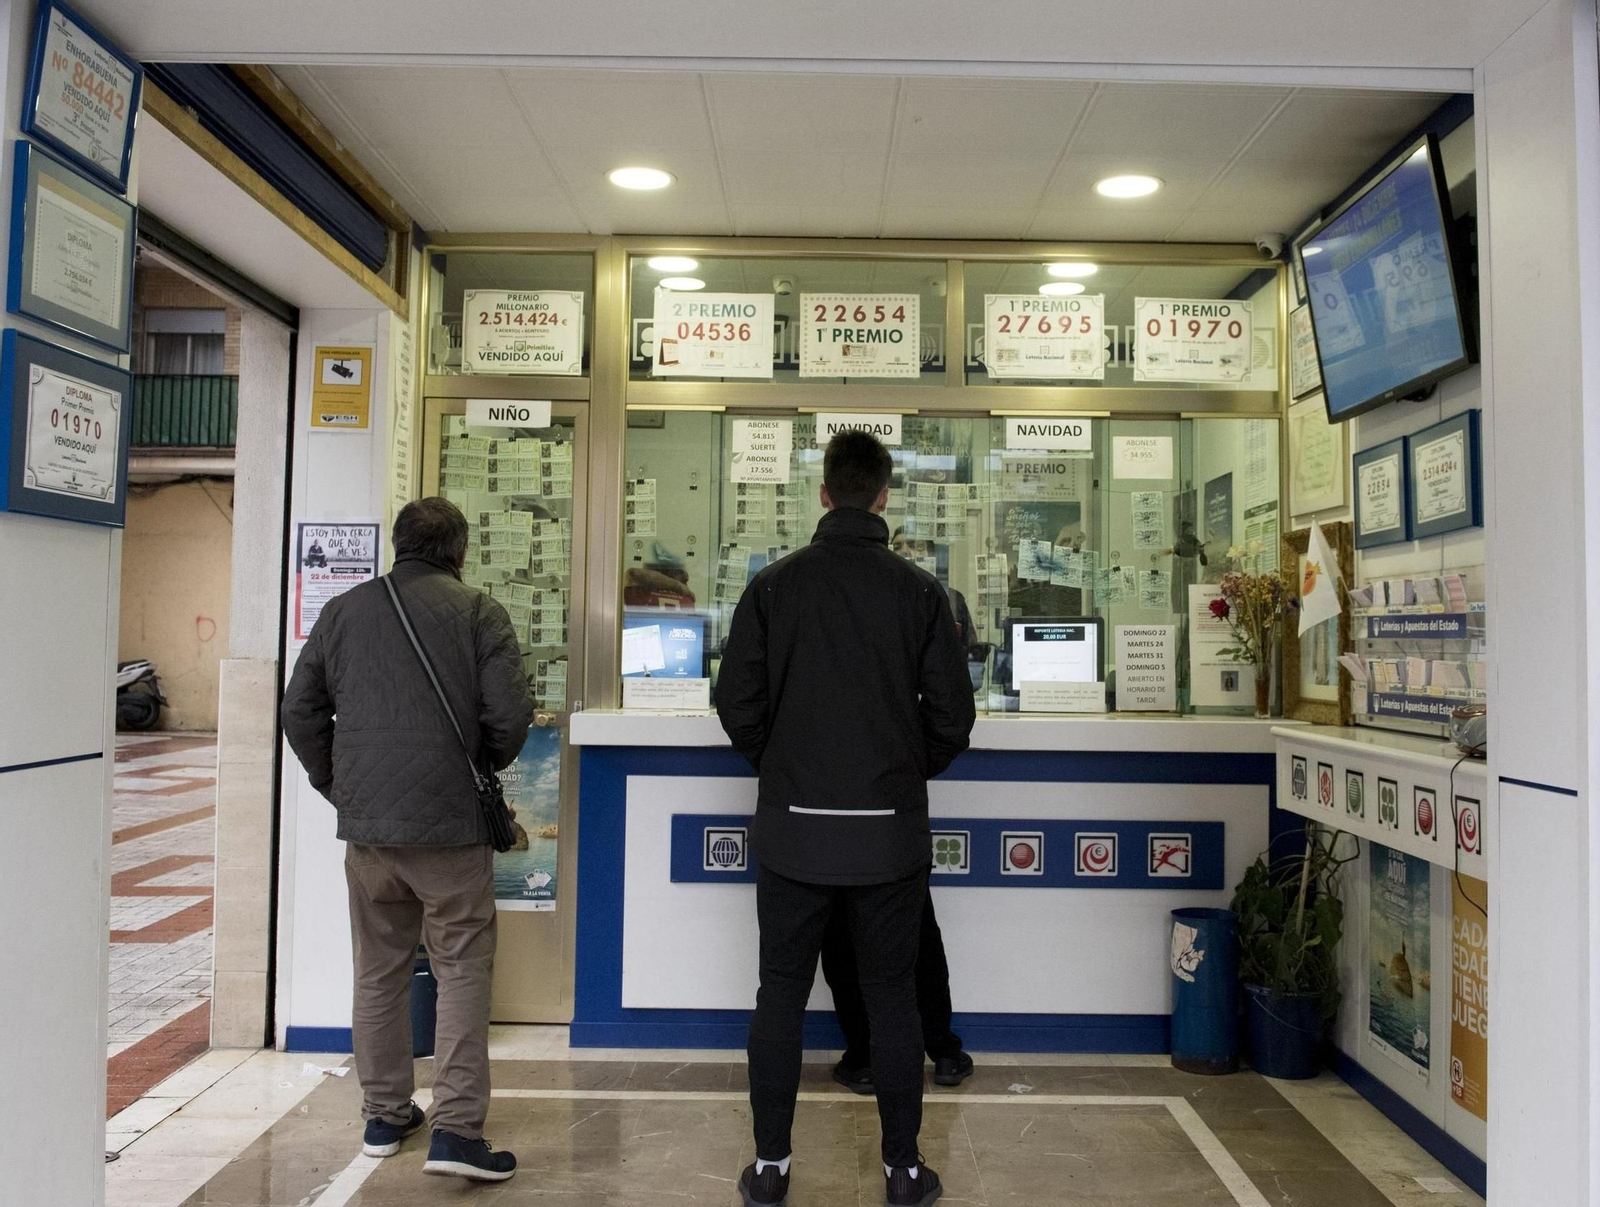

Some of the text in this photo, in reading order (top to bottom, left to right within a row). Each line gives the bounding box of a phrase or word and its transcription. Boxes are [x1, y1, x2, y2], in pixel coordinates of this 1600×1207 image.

[65, 39, 118, 89] ENHORABUENA
[63, 80, 94, 110] VENDIDO
[72, 61, 124, 120] 84442
[507, 294, 540, 302] PREMIO
[496, 303, 549, 311] MILLONARIO
[689, 303, 757, 318] PREMIO
[814, 304, 906, 323] 22654
[1022, 300, 1081, 313] PREMIO
[1172, 304, 1231, 318] PREMIO
[479, 312, 568, 326] 2.514.424 €
[997, 314, 1092, 334] 27695
[677, 322, 751, 341] 04536
[832, 328, 903, 343] PREMIO
[1146, 318, 1243, 339] 01970
[478, 350, 564, 362] VENDIDO AQUÍ
[65, 385, 93, 402] DIPLOMA
[61, 396, 95, 415] Primer Premio
[488, 404, 530, 421] NIÑO
[51, 408, 102, 440] 01970
[747, 421, 780, 429] ABONESE
[793, 423, 817, 434] EMIO
[1017, 424, 1083, 437] NAVIDAD
[54, 435, 81, 451] VENDIDO
[750, 443, 776, 451] SUERTE
[792, 437, 819, 450] 536
[1126, 439, 1157, 447] ABONESE
[746, 455, 778, 463] ABONESE
[750, 466, 773, 474] 17.556
[1016, 463, 1066, 474] PREMIO
[1367, 478, 1390, 496] 22654
[305, 528, 373, 539] ESTOY TAN CERCA
[328, 538, 361, 548] QUE NO
[337, 546, 368, 557] ME VES
[1380, 620, 1459, 633] Loterías y Apuestas del Estado
[1380, 698, 1456, 716] Loterías y Apuestas del Estad
